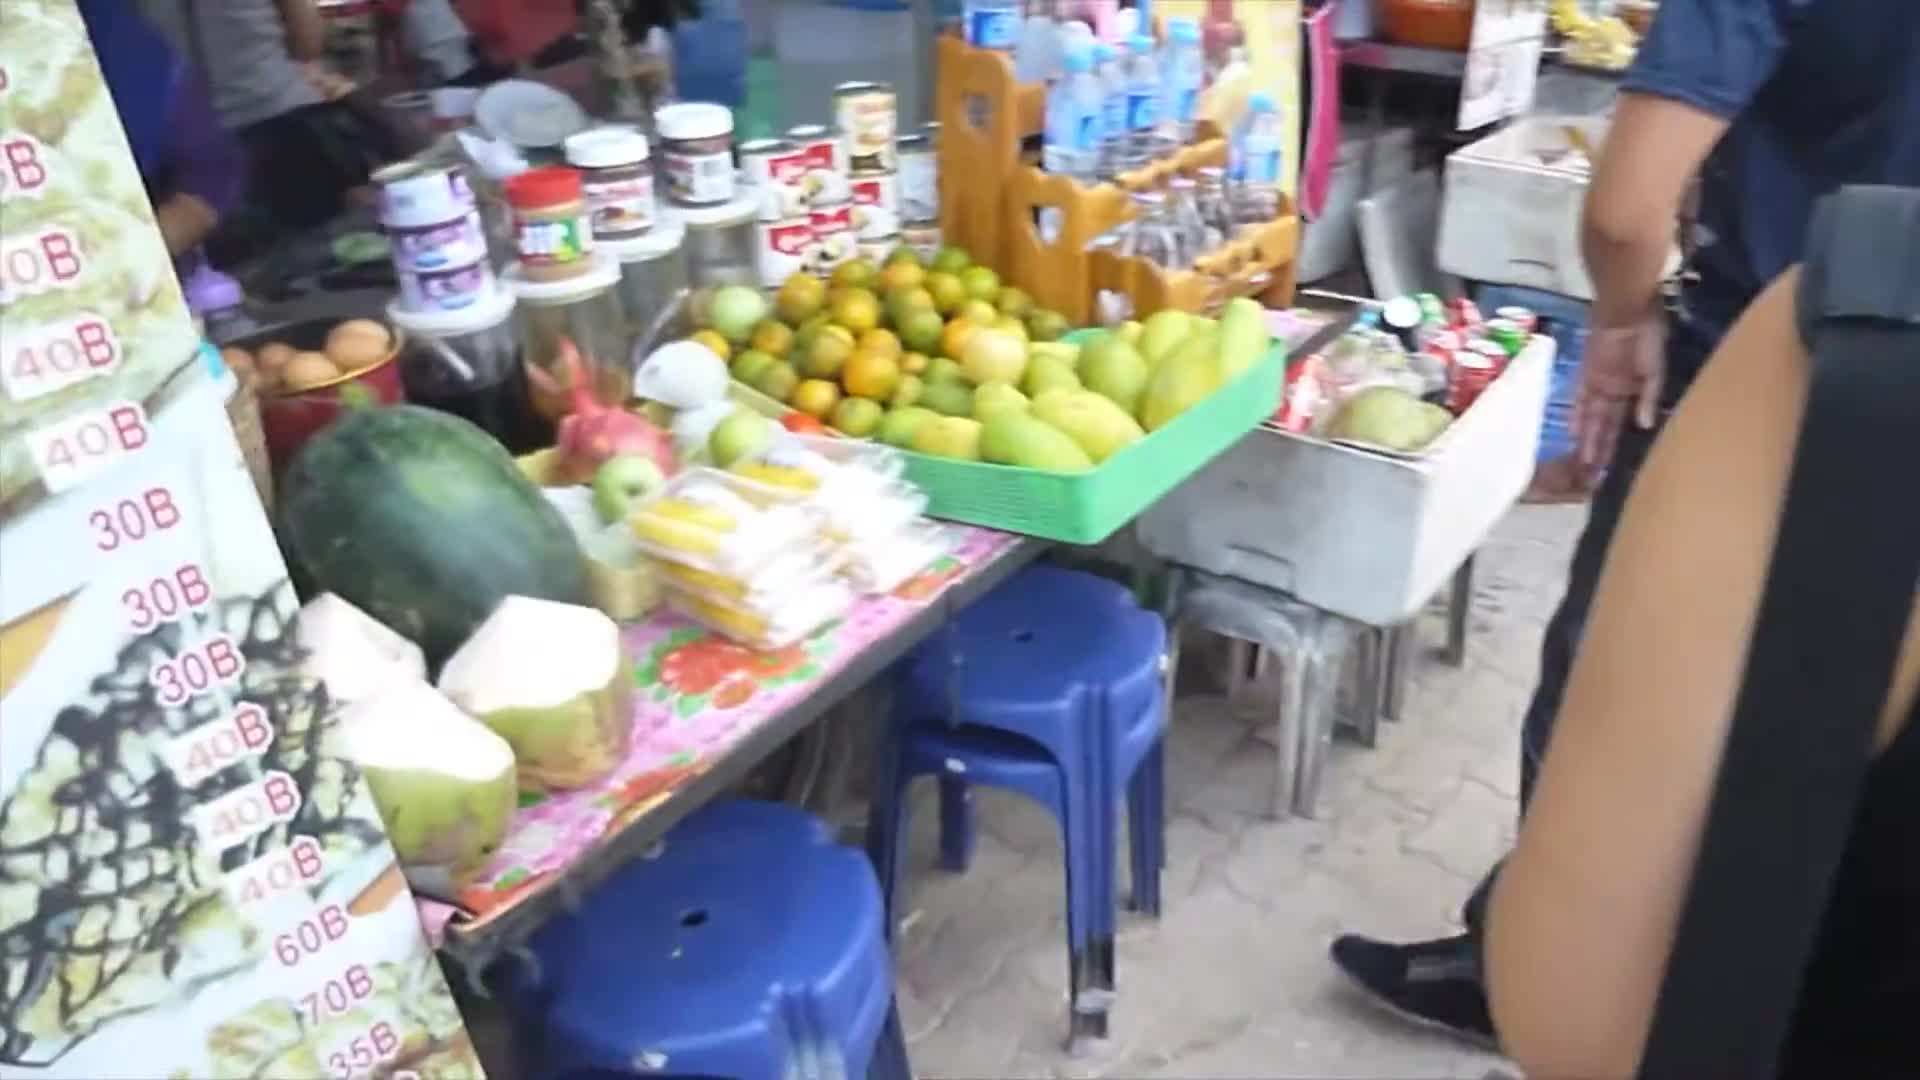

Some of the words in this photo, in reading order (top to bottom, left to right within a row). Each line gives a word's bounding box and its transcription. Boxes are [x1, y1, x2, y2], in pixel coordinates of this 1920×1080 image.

[0, 141, 46, 189] B
[0, 233, 81, 291] 0B
[13, 321, 115, 379] 40B
[47, 406, 147, 467] 40B
[89, 488, 181, 551] 30B
[122, 565, 210, 628] 30B
[156, 639, 239, 702] 30B
[187, 710, 268, 771] 40B
[212, 777, 295, 836] 40B
[241, 842, 322, 904] 40B
[275, 905, 349, 966] 60B
[301, 964, 373, 1026] 70B
[329, 1021, 398, 1080] 35B
